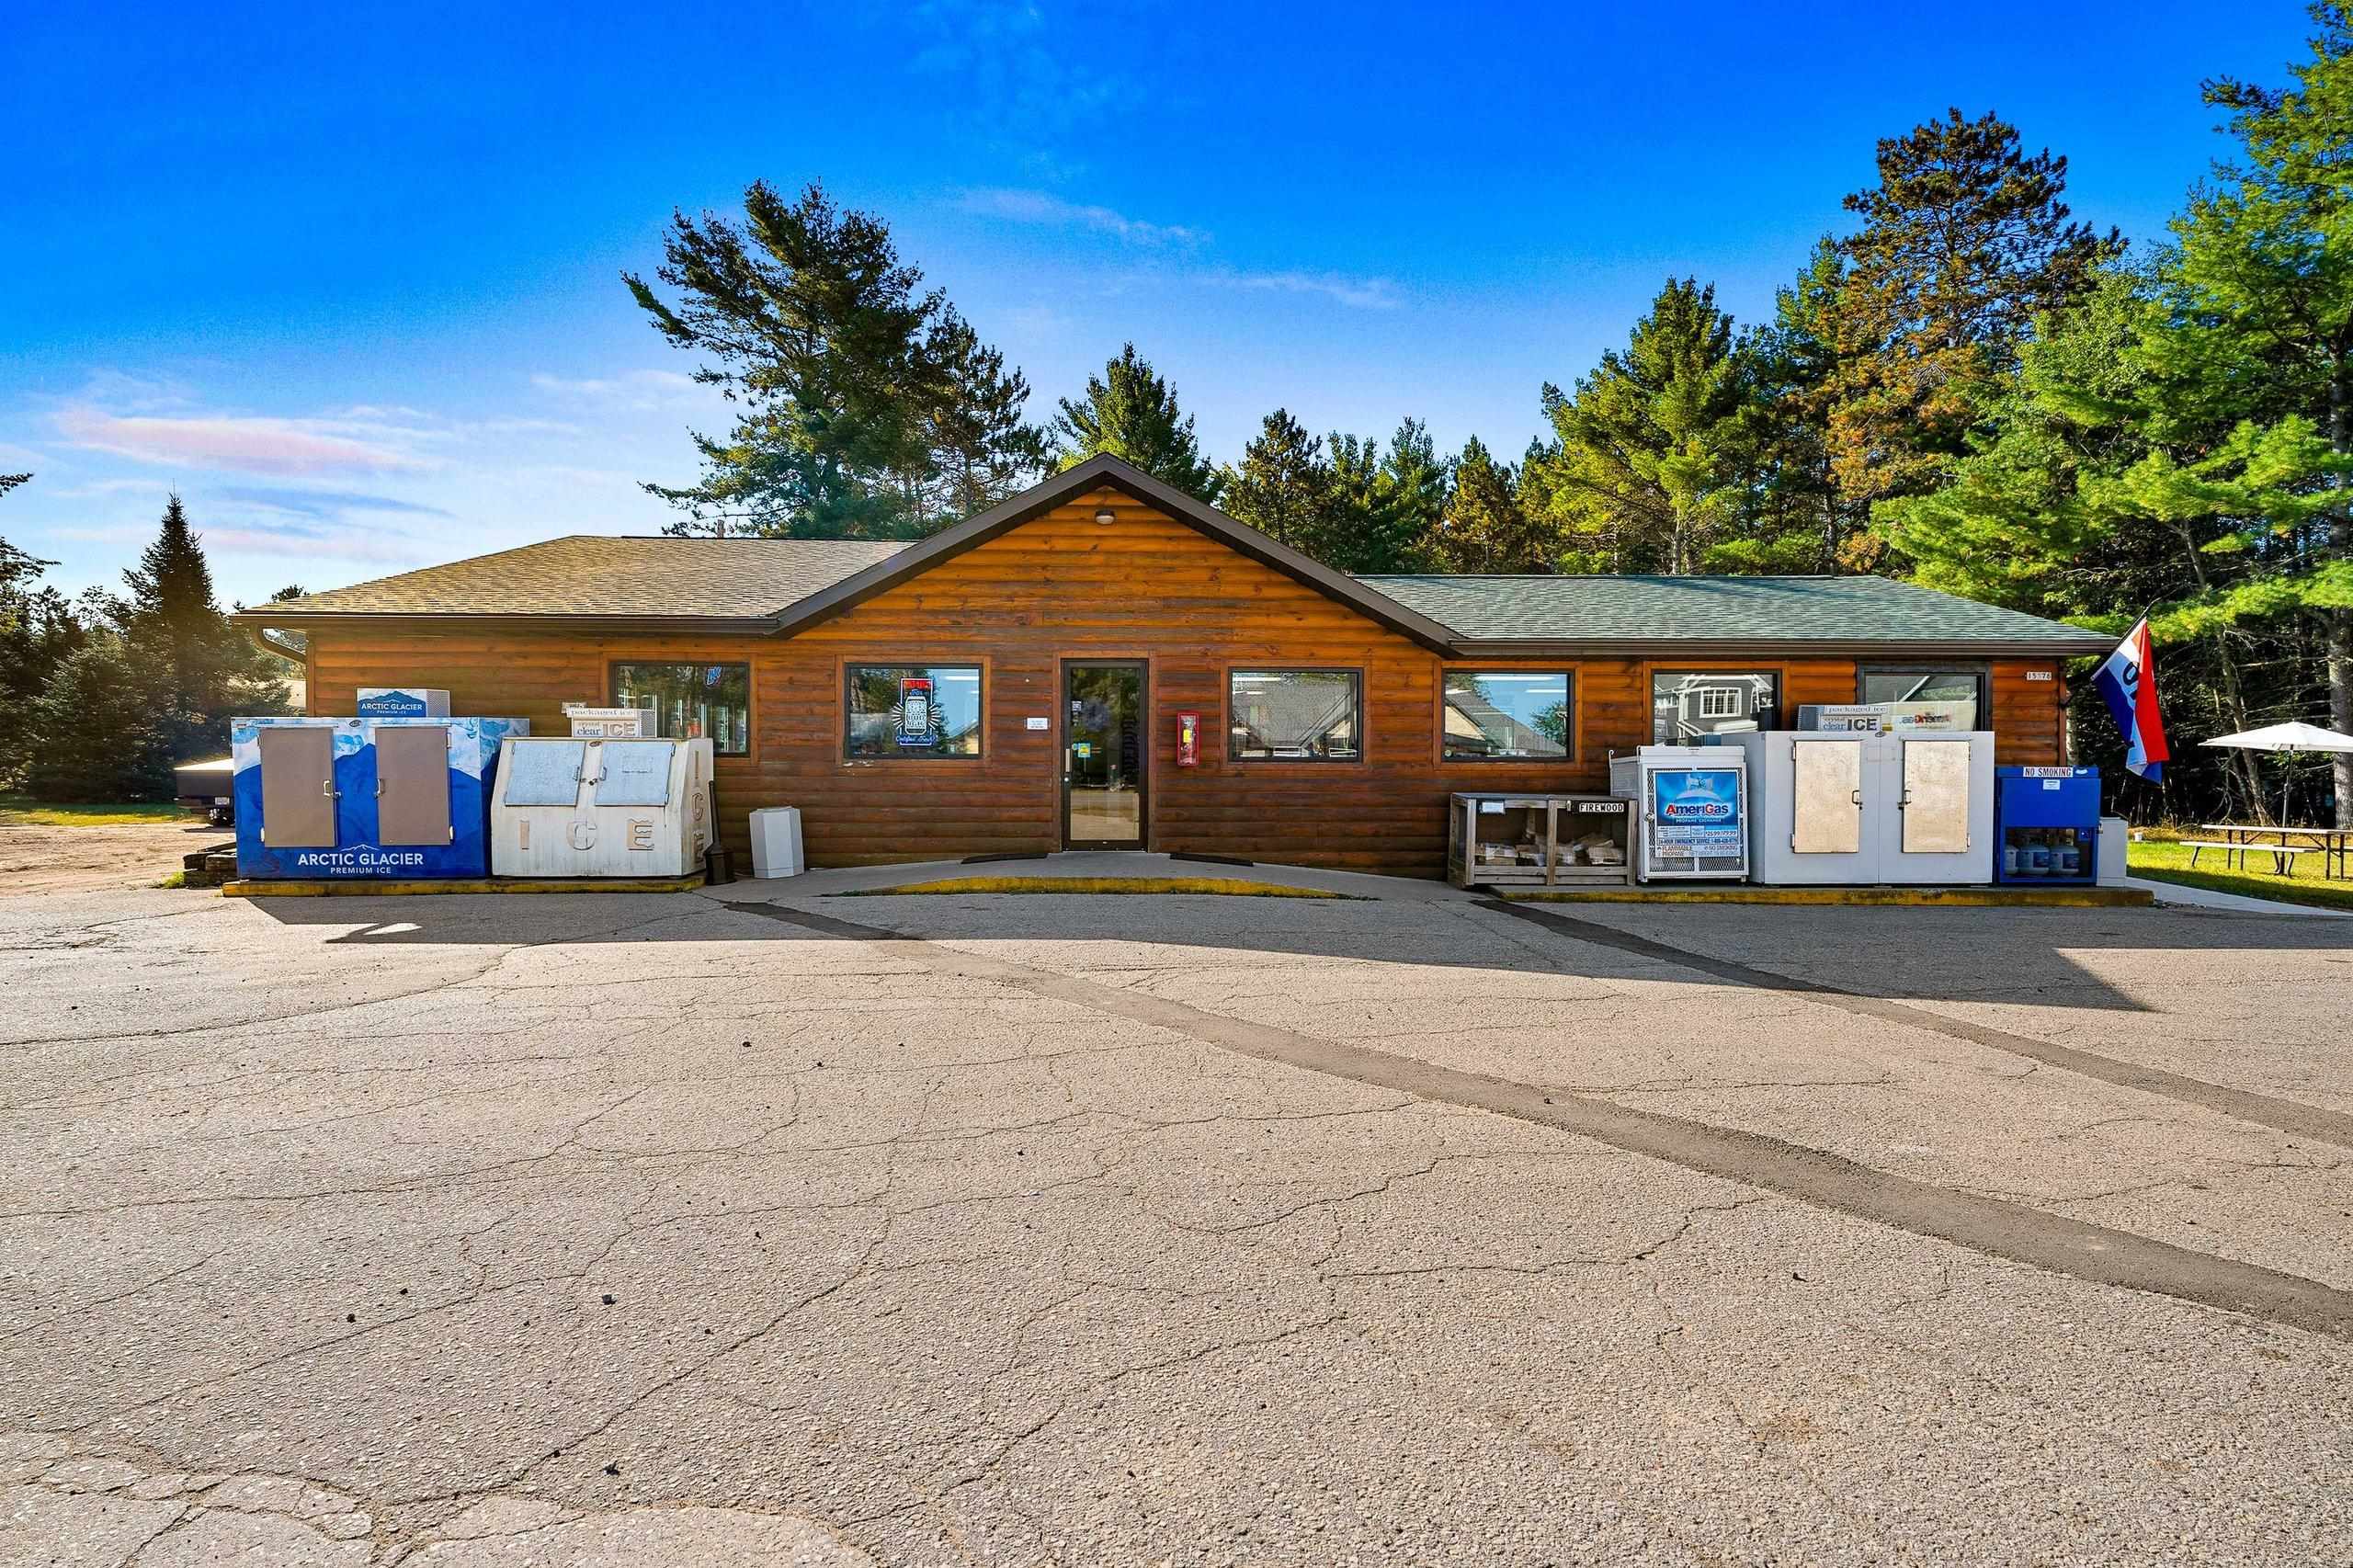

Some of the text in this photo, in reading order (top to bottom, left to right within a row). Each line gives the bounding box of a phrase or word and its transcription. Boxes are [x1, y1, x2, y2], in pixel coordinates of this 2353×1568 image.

[577, 722, 636, 736] clear ICE
[1823, 718, 1878, 732] clear ICE
[2025, 767, 2072, 777] NO SMOKING
[1579, 802, 1624, 812] FIREWOOD
[1665, 803, 1729, 814] AmeriGas
[297, 853, 424, 866] ARCTIC GLACIER
